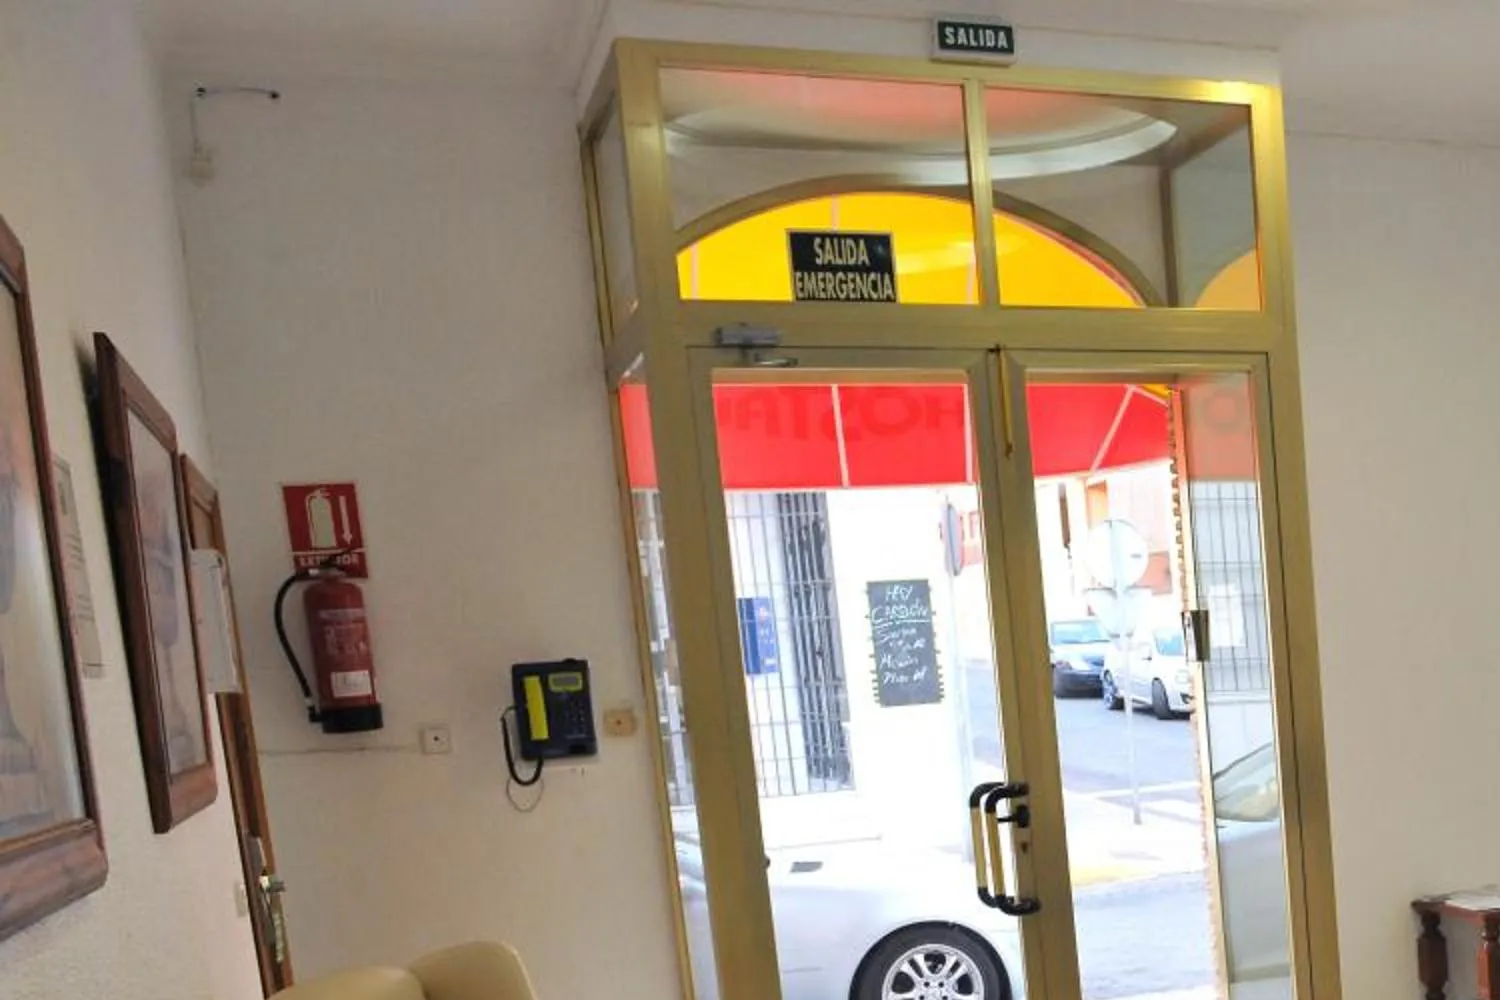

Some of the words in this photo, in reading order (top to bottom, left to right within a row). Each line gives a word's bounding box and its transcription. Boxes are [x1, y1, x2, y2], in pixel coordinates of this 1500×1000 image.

[944, 26, 1009, 49] SALIDA
[813, 237, 871, 266] SALIDA
[795, 270, 895, 300] EMERGENCIA
[300, 554, 359, 568] EXTTOR
